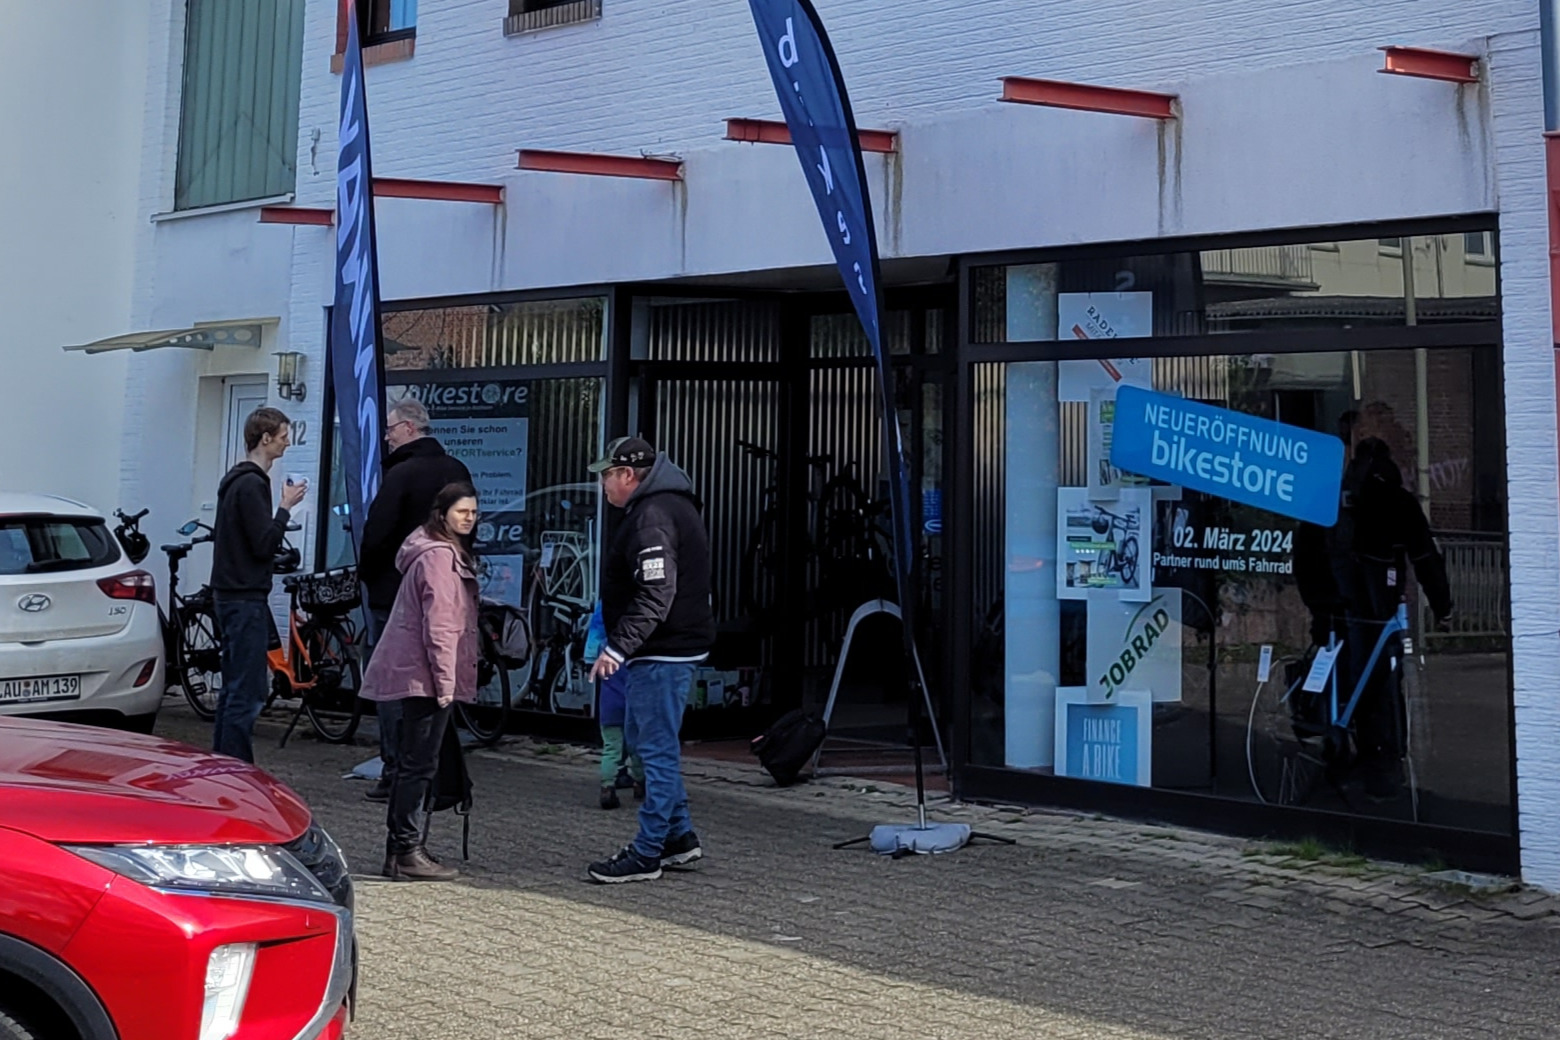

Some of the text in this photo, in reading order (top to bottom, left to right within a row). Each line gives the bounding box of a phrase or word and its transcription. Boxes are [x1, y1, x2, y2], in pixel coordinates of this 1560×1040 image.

[291, 420, 307, 445] 12
[460, 425, 475, 434] Sie
[478, 424, 508, 433] schon
[1144, 402, 1308, 465] NEUERÖFFNUNG
[1151, 430, 1295, 502] bikestore
[1173, 526, 1293, 553] 02. März 2024
[1153, 552, 1192, 568] Partner
[1194, 555, 1219, 569] rund
[1249, 557, 1293, 574] Fahrrad
[1099, 608, 1169, 699] JOBRAD
[0, 677, 78, 699] AU AM 139
[1083, 718, 1121, 744] FINANCE
[1083, 743, 1121, 779] A BIKE
